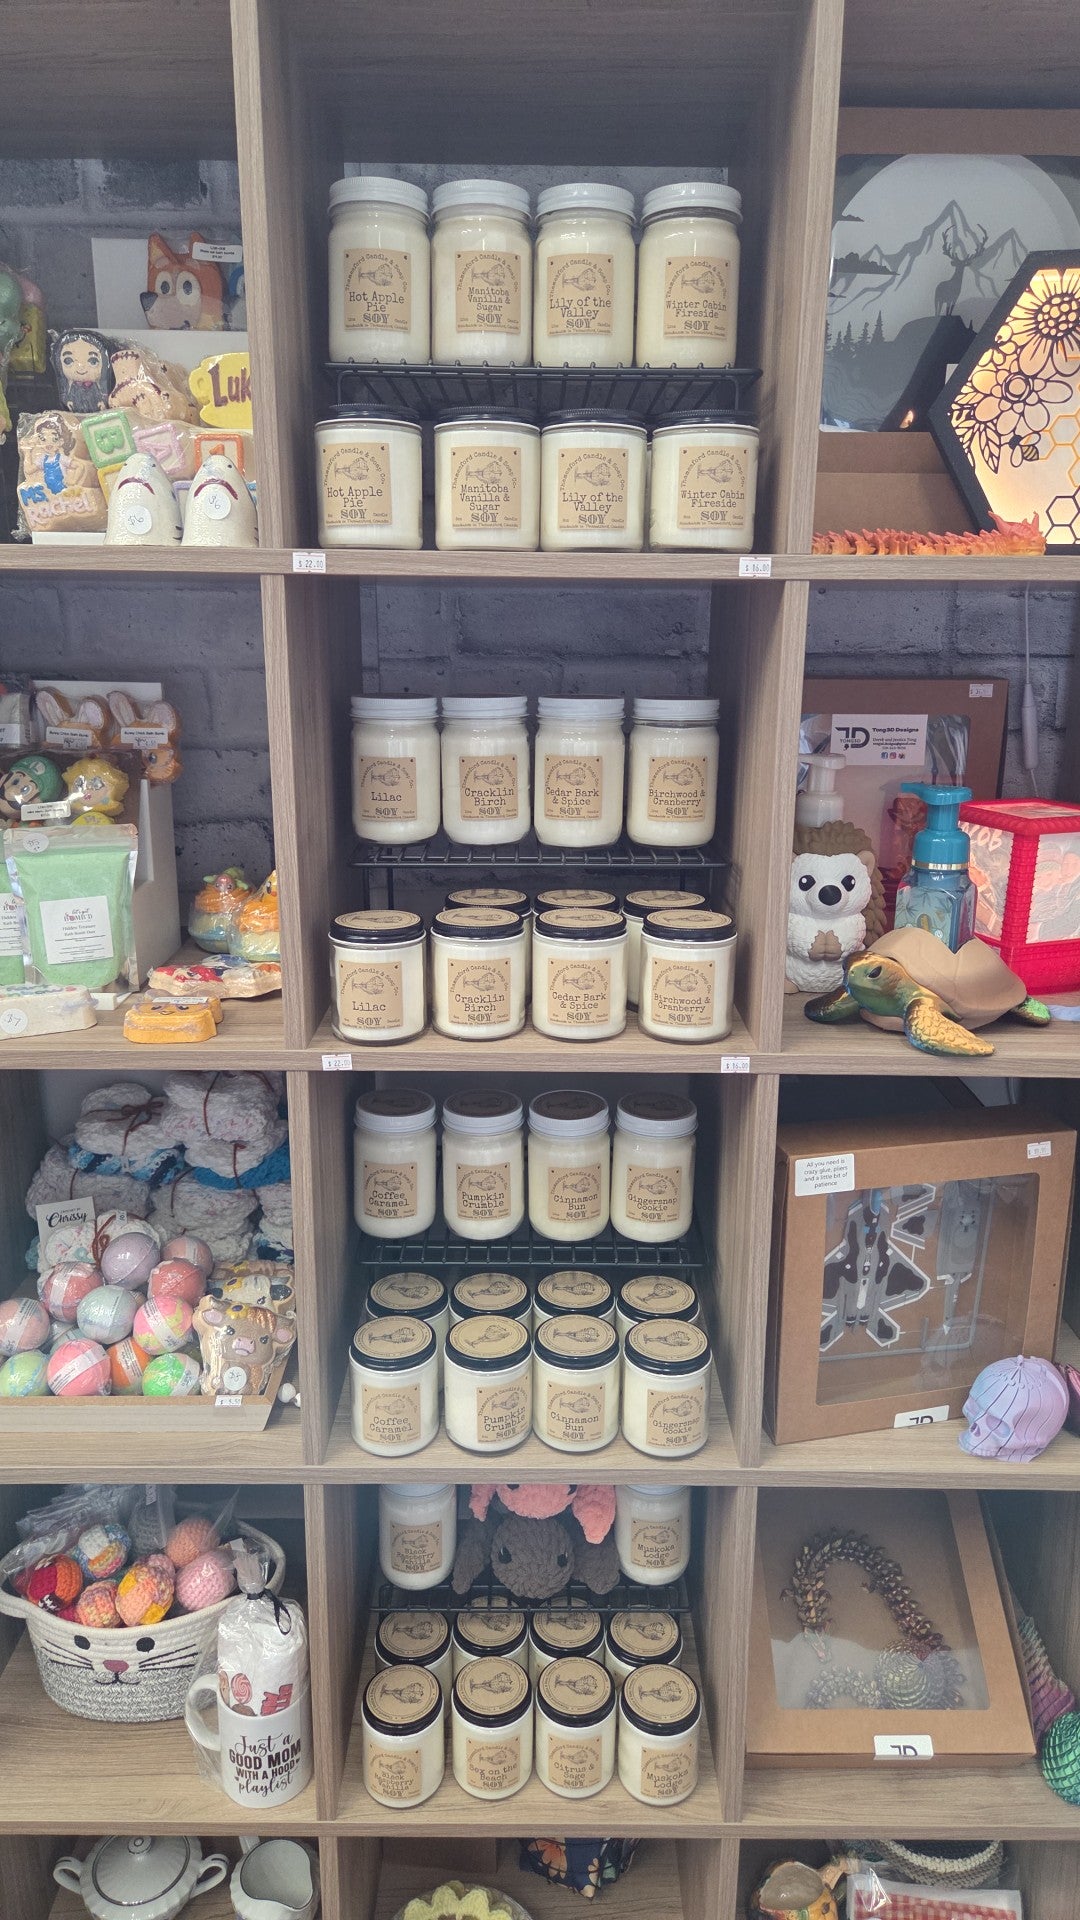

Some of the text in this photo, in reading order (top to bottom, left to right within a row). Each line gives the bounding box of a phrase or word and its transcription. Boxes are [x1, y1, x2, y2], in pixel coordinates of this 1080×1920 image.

[468, 287, 510, 296] Manitoba
[349, 291, 404, 305] Hot Apple
[468, 294, 510, 304] Vanilla &
[550, 296, 612, 308] Lily of the
[366, 302, 386, 312] Pie
[476, 303, 502, 312] Sugar
[666, 300, 726, 311] Winter Cabin
[363, 312, 390, 324] SOY
[476, 313, 503, 323] SOY
[560, 307, 600, 320] Valley
[676, 309, 719, 318] Fireside
[566, 318, 591, 328] SOY
[684, 320, 710, 330] SOY
[327, 486, 384, 500] Hot Apple
[460, 484, 509, 493] Manitoba
[460, 493, 510, 502] Vanilla &
[562, 492, 624, 502] Lily of the
[681, 490, 745, 499] Winter Cabin
[343, 498, 364, 508] Pie
[470, 502, 500, 512] Sugar
[574, 502, 612, 514] Valley
[691, 499, 737, 508] Fireside
[340, 508, 367, 519] SOY
[471, 512, 498, 522] SOY
[700, 510, 728, 520] SOY
[578, 514, 606, 524] SOY
[371, 792, 402, 802] Lilac
[464, 788, 514, 797] Cracklin
[545, 787, 600, 797] Cedar Bark
[649, 788, 698, 798] Birchwood
[474, 797, 506, 806] Birch
[562, 797, 590, 806] Spice
[653, 797, 701, 807] Cranberry
[455, 993, 505, 1004] Cracklin
[552, 991, 606, 1001] Cedar Bark
[654, 994, 710, 1004] Birchwood &
[352, 1001, 386, 1011] Lilac
[464, 1003, 496, 1012] Birch
[560, 1001, 598, 1011] & Spice
[658, 1002, 706, 1013] Cranberry
[468, 1012, 492, 1022] SOY
[566, 1012, 592, 1020] SOY
[668, 1013, 693, 1022] SOY
[357, 1017, 382, 1026] SOY
[372, 1191, 405, 1200] Coffee
[462, 1192, 504, 1201] Pumpkin
[553, 1194, 598, 1204] Cinnamon
[628, 1194, 677, 1205] Gingersnap
[369, 1198, 409, 1208] Caramel
[462, 1200, 504, 1208] Crumble
[637, 1203, 668, 1211] Cookie
[46, 1212, 88, 1227] Chrissy
[484, 1406, 526, 1424] Pumpkin
[550, 1412, 599, 1424] Cinnamon
[374, 1417, 408, 1425] Coffee
[484, 1416, 525, 1432] Crumble
[652, 1417, 700, 1429] Gingersnap
[370, 1423, 413, 1433] Caramel
[565, 1423, 584, 1431] Bun
[235, 1734, 293, 1757] Just a
[229, 1738, 300, 1770] GOOD MOM
[236, 1760, 294, 1780] WITH A HOOD
[504, 1763, 517, 1772] the
[554, 1762, 586, 1772] Citrus
[564, 1772, 585, 1780] Sage
[647, 1769, 688, 1781] Muskoka
[239, 1770, 295, 1797] playlist
[654, 1780, 683, 1789] Lodge
